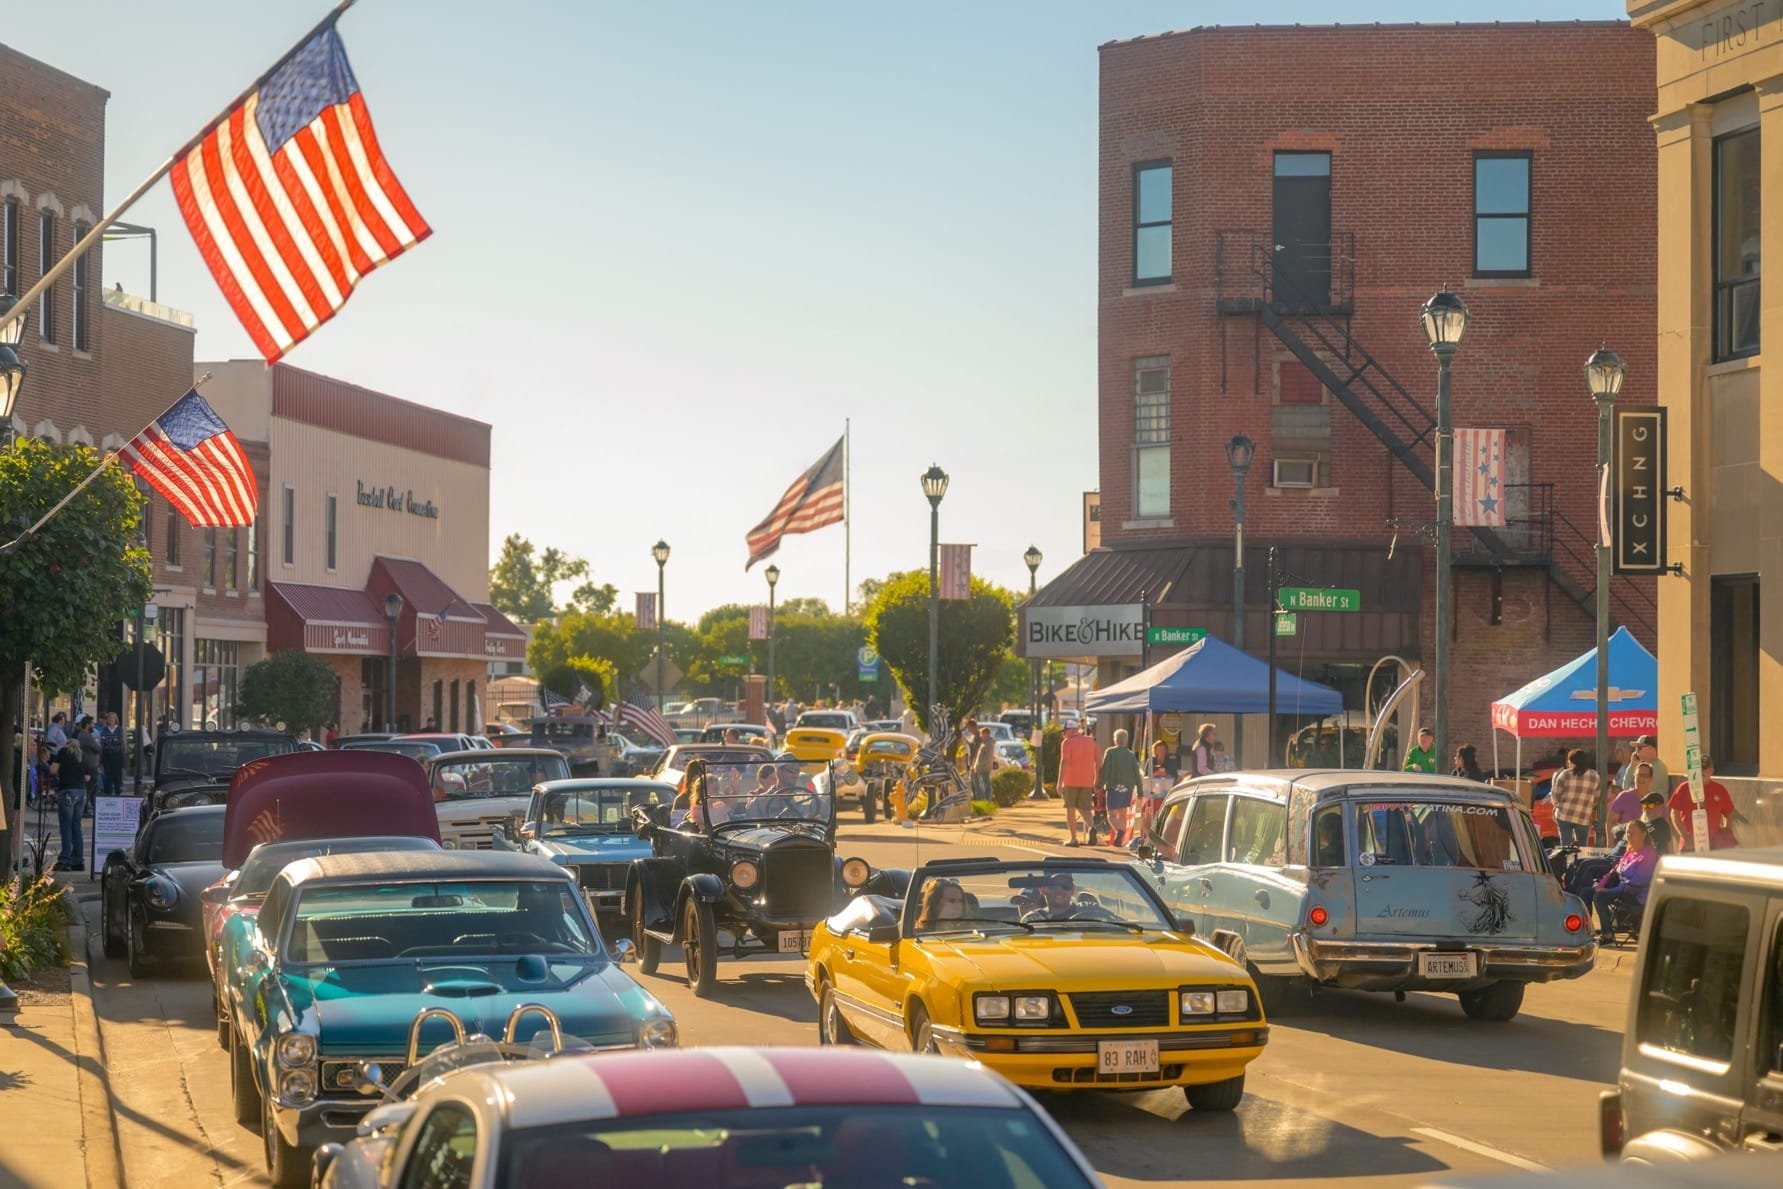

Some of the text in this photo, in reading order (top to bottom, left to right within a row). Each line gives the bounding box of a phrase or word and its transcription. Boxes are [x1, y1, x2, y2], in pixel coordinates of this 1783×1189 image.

[1702, 2, 1764, 61] FIRST
[1632, 426, 1648, 555] XCHNG
[1290, 592, 1349, 608] N Banker St
[1161, 630, 1190, 641] Banker
[1528, 717, 1658, 729] DAN HECH CHEVR
[1377, 903, 1431, 919] Artemus
[1427, 960, 1464, 974] ARTEMUS
[1104, 1050, 1119, 1067] 83
[1125, 1049, 1146, 1066] RAH
